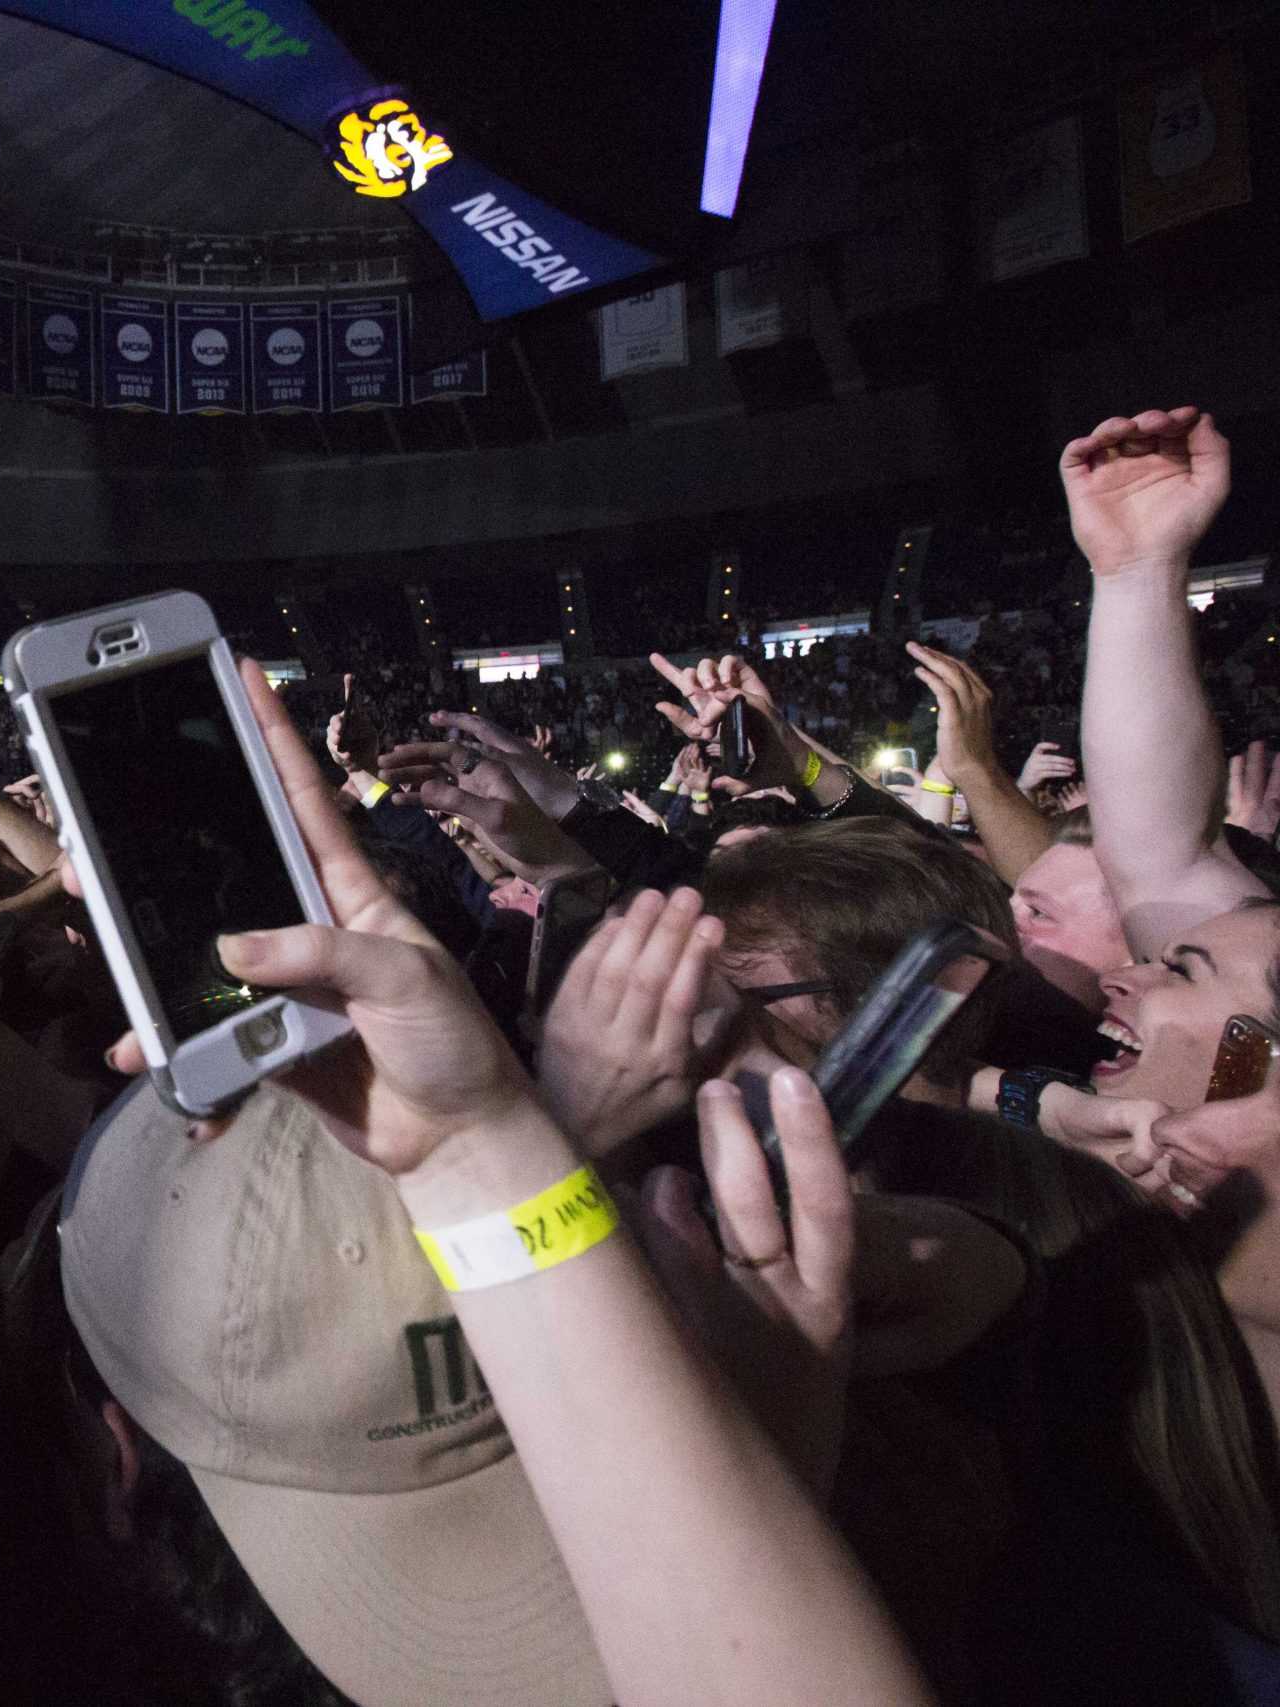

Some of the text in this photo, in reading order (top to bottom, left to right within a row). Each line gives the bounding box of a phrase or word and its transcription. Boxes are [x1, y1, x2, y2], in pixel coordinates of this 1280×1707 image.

[450, 191, 590, 294] NISSAN
[121, 341, 151, 352] NCAA
[350, 336, 383, 348] NCAA
[196, 346, 228, 356] NCAA
[272, 345, 304, 355] NCAA
